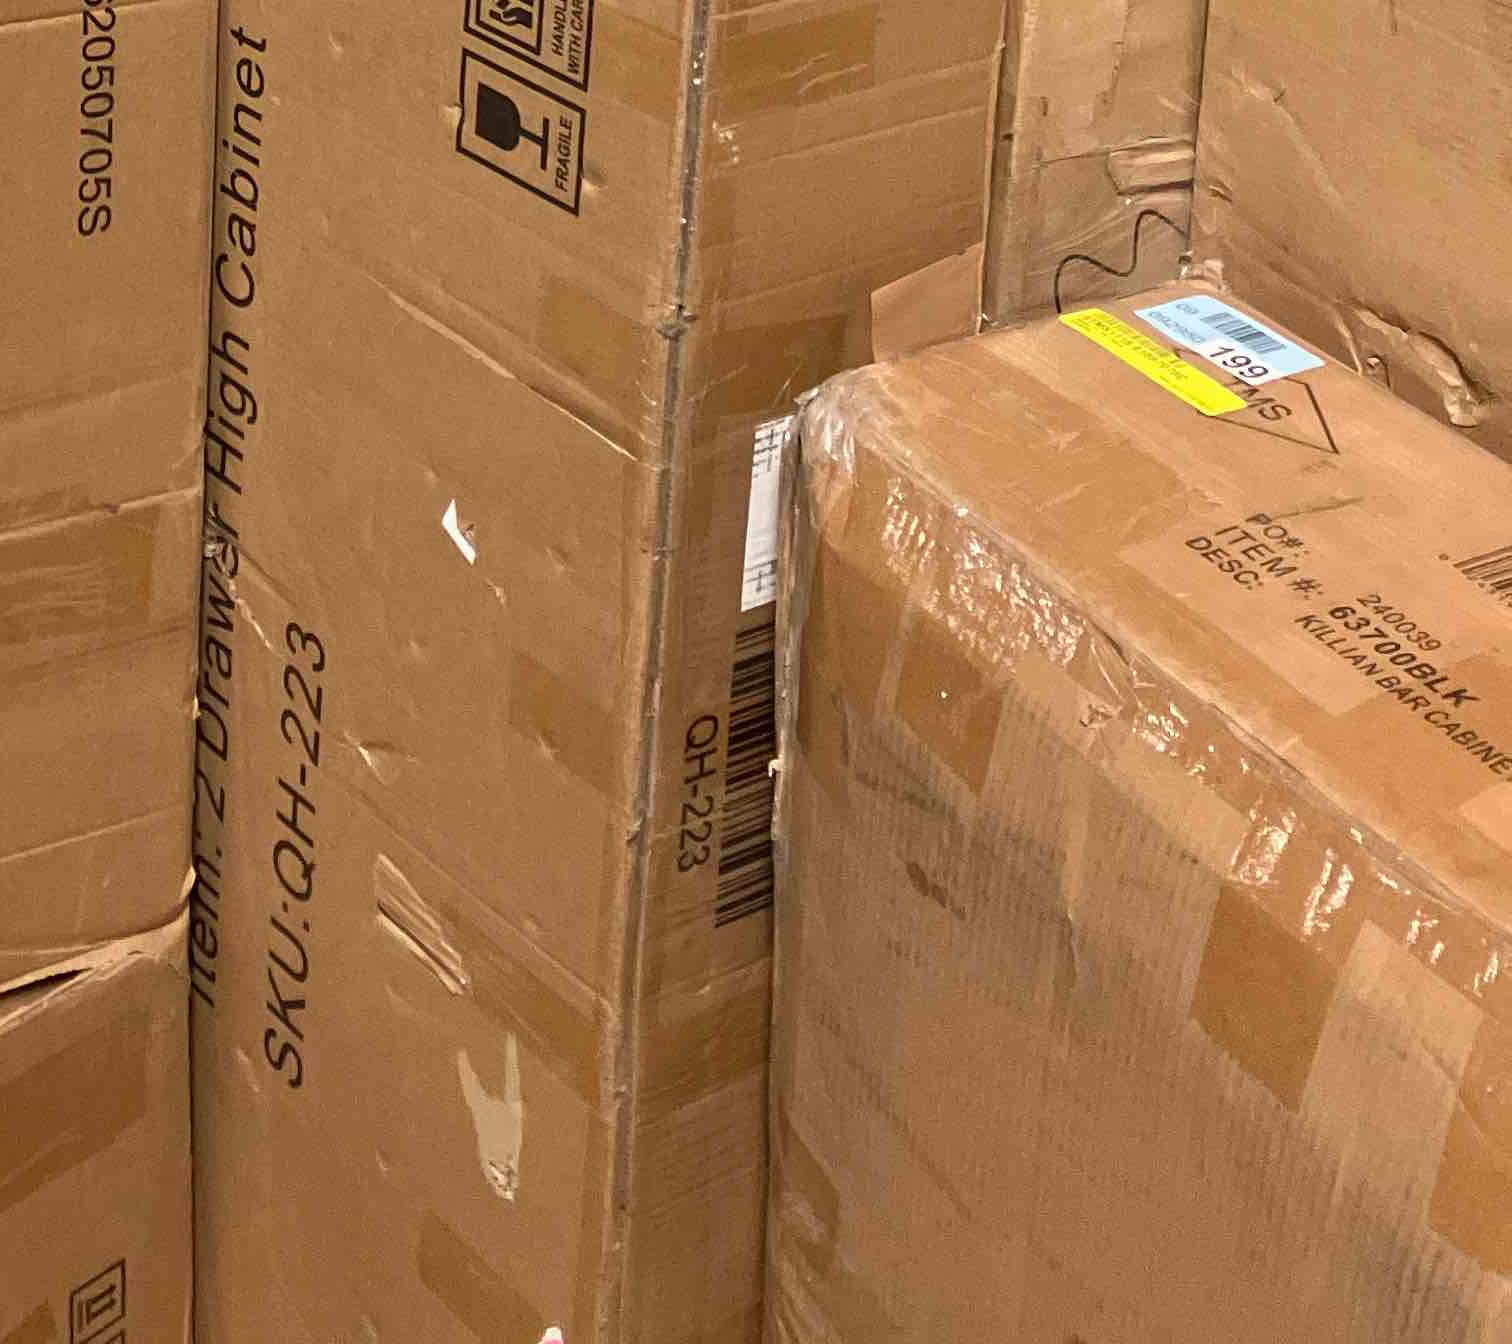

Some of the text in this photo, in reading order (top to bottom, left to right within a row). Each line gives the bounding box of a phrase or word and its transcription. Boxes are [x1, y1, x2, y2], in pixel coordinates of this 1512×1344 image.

[567, 33, 583, 77] WITH
[214, 25, 267, 308] Cabinet
[554, 116, 573, 193] FRAGILE
[205, 328, 258, 496] High
[1209, 346, 1269, 379] 199
[1184, 535, 1512, 782] DESC: KILLIAN BAR CABINE
[1214, 525, 1299, 578] ITEM
[1327, 605, 1481, 709] 63700BLK
[1245, 512, 1442, 653] PO#: 240039
[263, 621, 326, 1090] SKU:QH-223
[677, 714, 719, 873] QH-223
